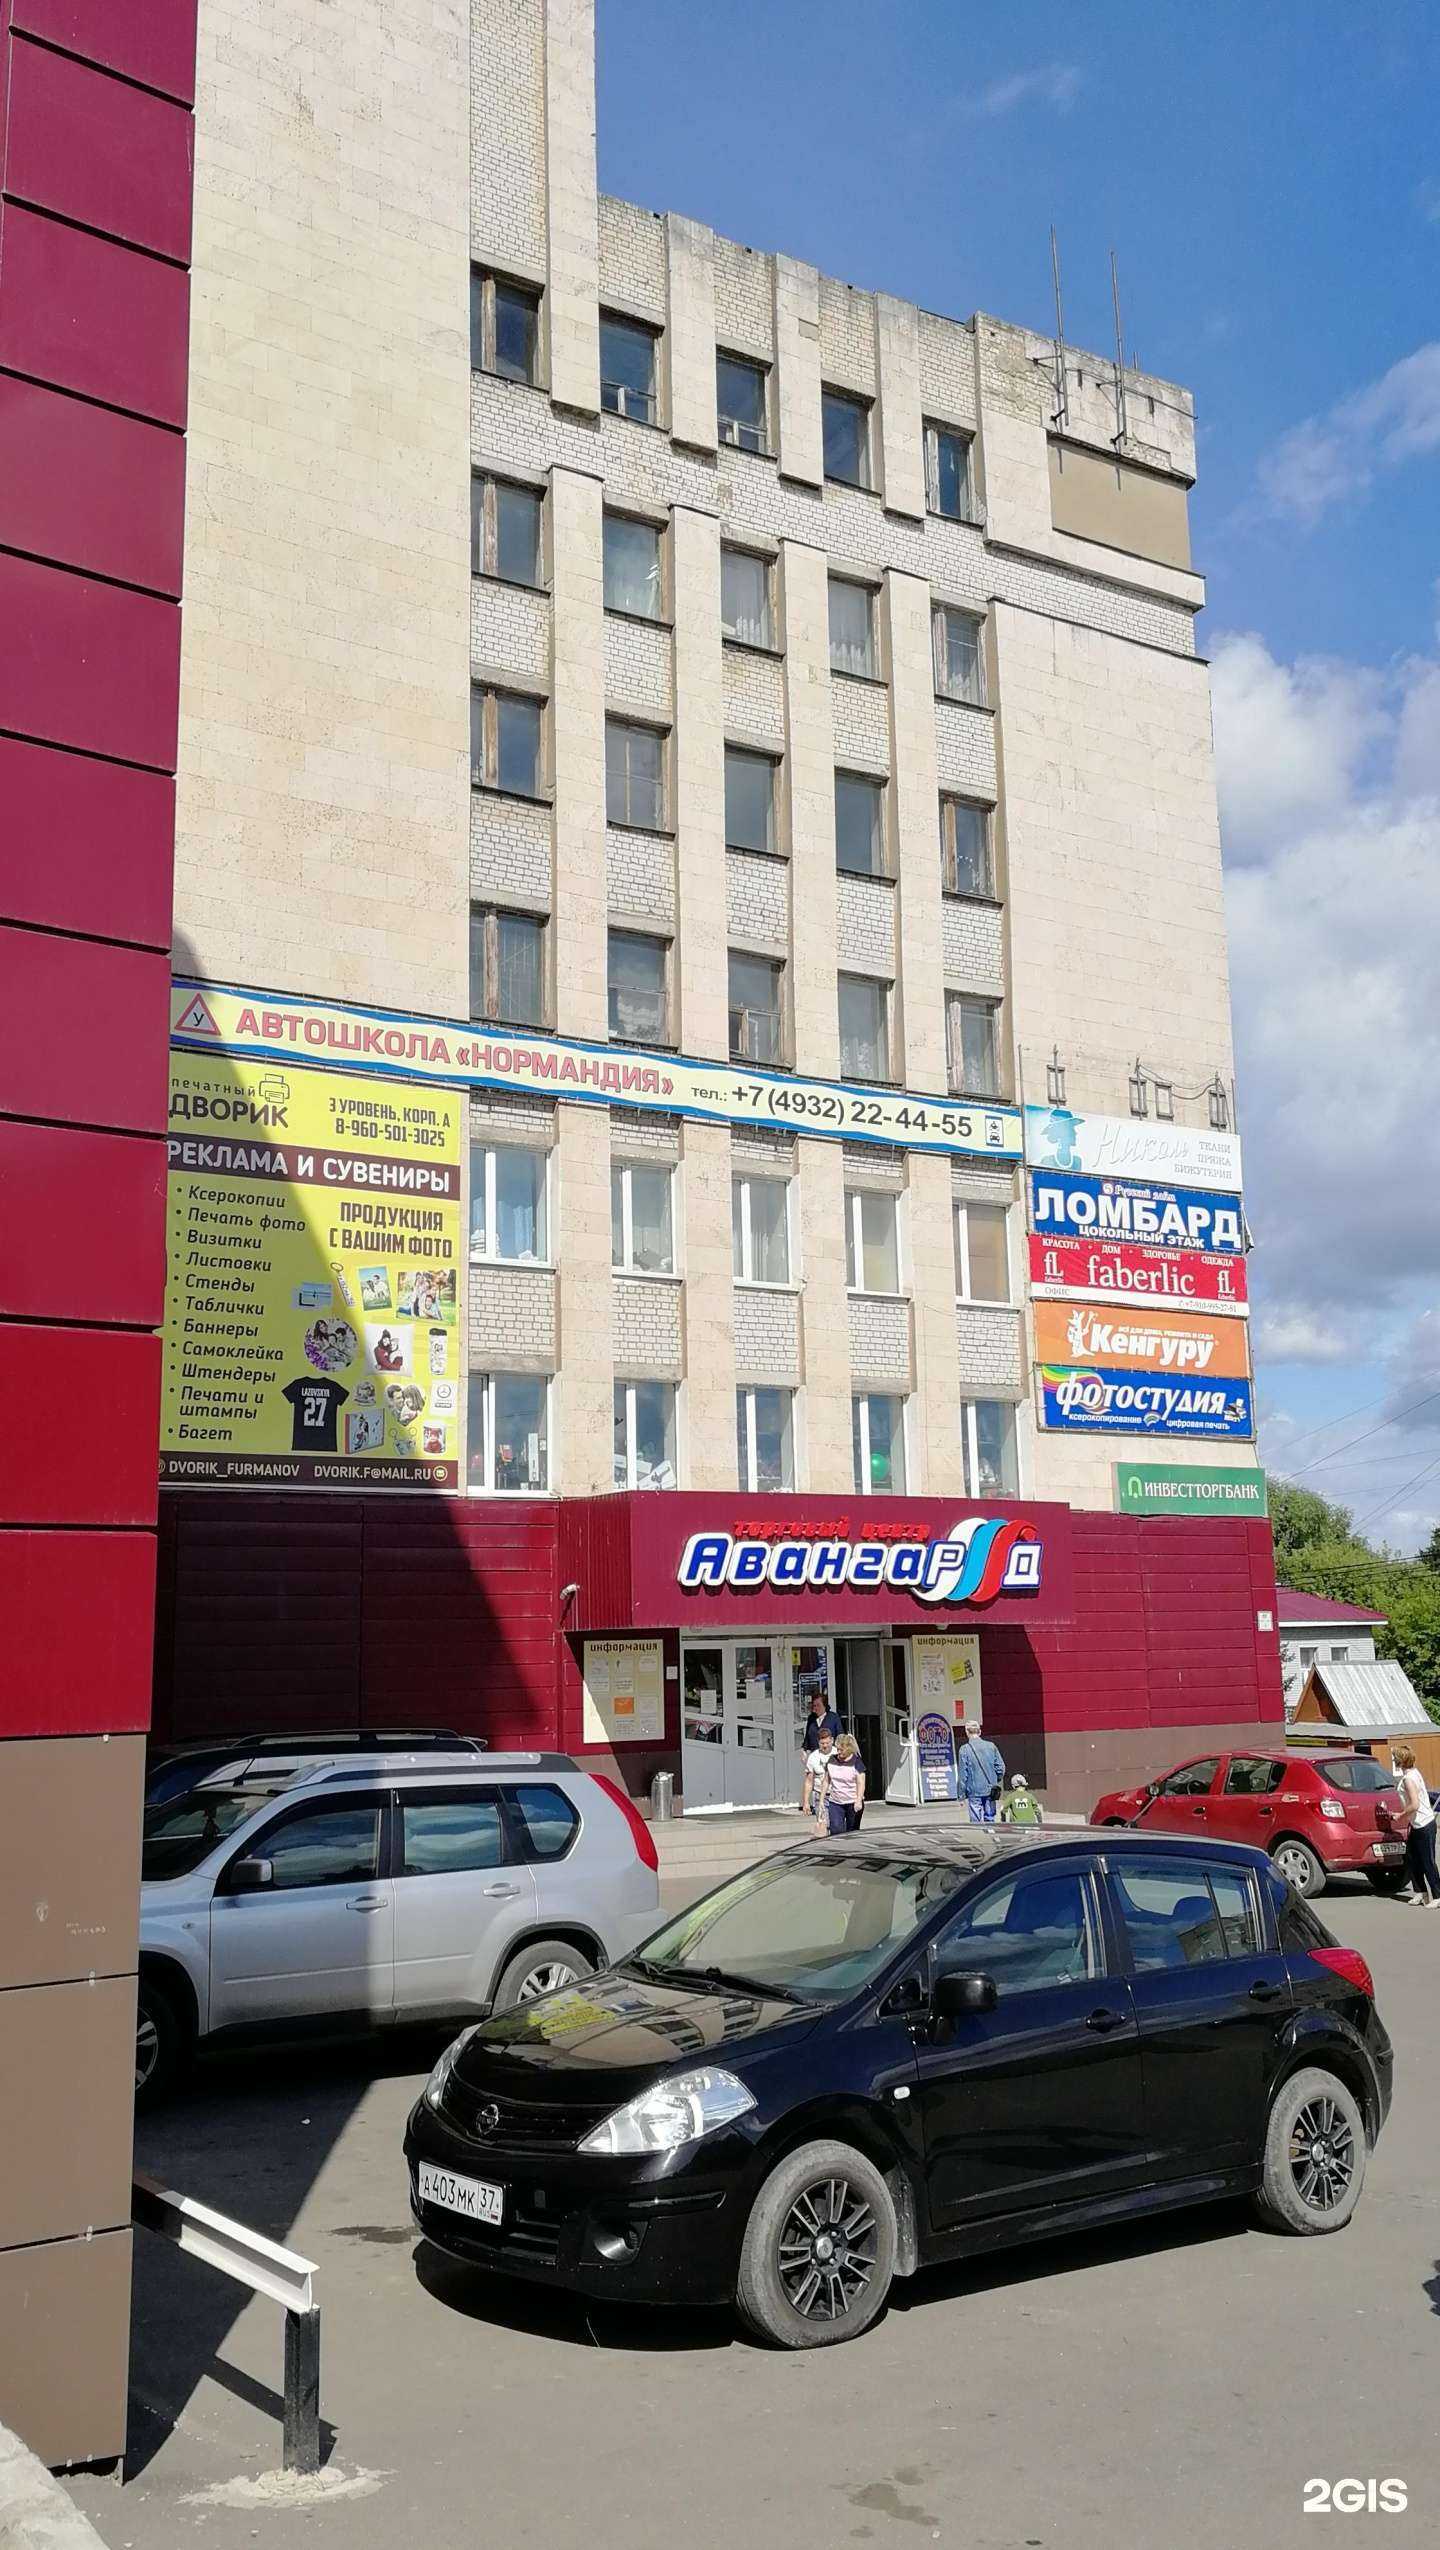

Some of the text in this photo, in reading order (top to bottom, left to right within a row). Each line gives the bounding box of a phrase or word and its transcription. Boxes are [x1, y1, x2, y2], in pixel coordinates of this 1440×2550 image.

[235, 1008, 674, 1095] АВТОШКОЛА «НОРМАНДИЯ»
[171, 1077, 256, 1097] печатный
[691, 1086, 727, 1103] тел.:
[169, 1093, 289, 1129] ДВОРИК
[329, 1097, 450, 1128] 3 УРОВЕНЬ, КОРП. А
[335, 1117, 445, 1147] 8-960-501-3025
[1199, 1141, 1231, 1154] ТКАНИ
[167, 1140, 450, 1193] РЕКЛАМА И СУВЕНИРЫ
[188, 1184, 285, 1208] Ксерокопии
[187, 1207, 306, 1232] Печать фото
[340, 1201, 443, 1232] ПРОДУКЦИЯ
[1035, 1188, 1242, 1249] ЛОМБАРД
[187, 1229, 262, 1249] Визитки
[329, 1228, 453, 1258] С ВАШИМ ФОТО
[1042, 1238, 1080, 1250] КРАСОТА
[1078, 1224, 1204, 1248] ЦОКОЛЬНЫЙ ЭТАЖ
[1101, 1245, 1121, 1255] ДОМ
[1142, 1249, 1181, 1262] ЗДОРОВЬЕ
[185, 1251, 272, 1272] Листовки
[1201, 1255, 1234, 1267] ОДЕЖДА
[185, 1273, 255, 1293] Стенды
[1087, 1254, 1196, 1296] faberlic
[185, 1295, 264, 1315] Таблички
[184, 1318, 259, 1339] Баннеры
[183, 1340, 284, 1361] Самоклейка
[1089, 1322, 1215, 1368] Кенгуру
[182, 1362, 276, 1385] Штендеры
[181, 1385, 264, 1404] Печати и
[179, 1405, 257, 1420] штампы
[303, 1397, 328, 1427] 27
[1068, 1413, 1142, 1424] ксерокопирование
[178, 1424, 232, 1441] Багет
[169, 1461, 300, 1478] DVORIK_FURMANOV
[314, 1465, 431, 1481] DVORIK.F@MAIL.RU
[1144, 1484, 1259, 1499] ИНВЕСТТОРГБАНК
[590, 1642, 658, 1653] информация
[917, 1637, 975, 1646] информация
